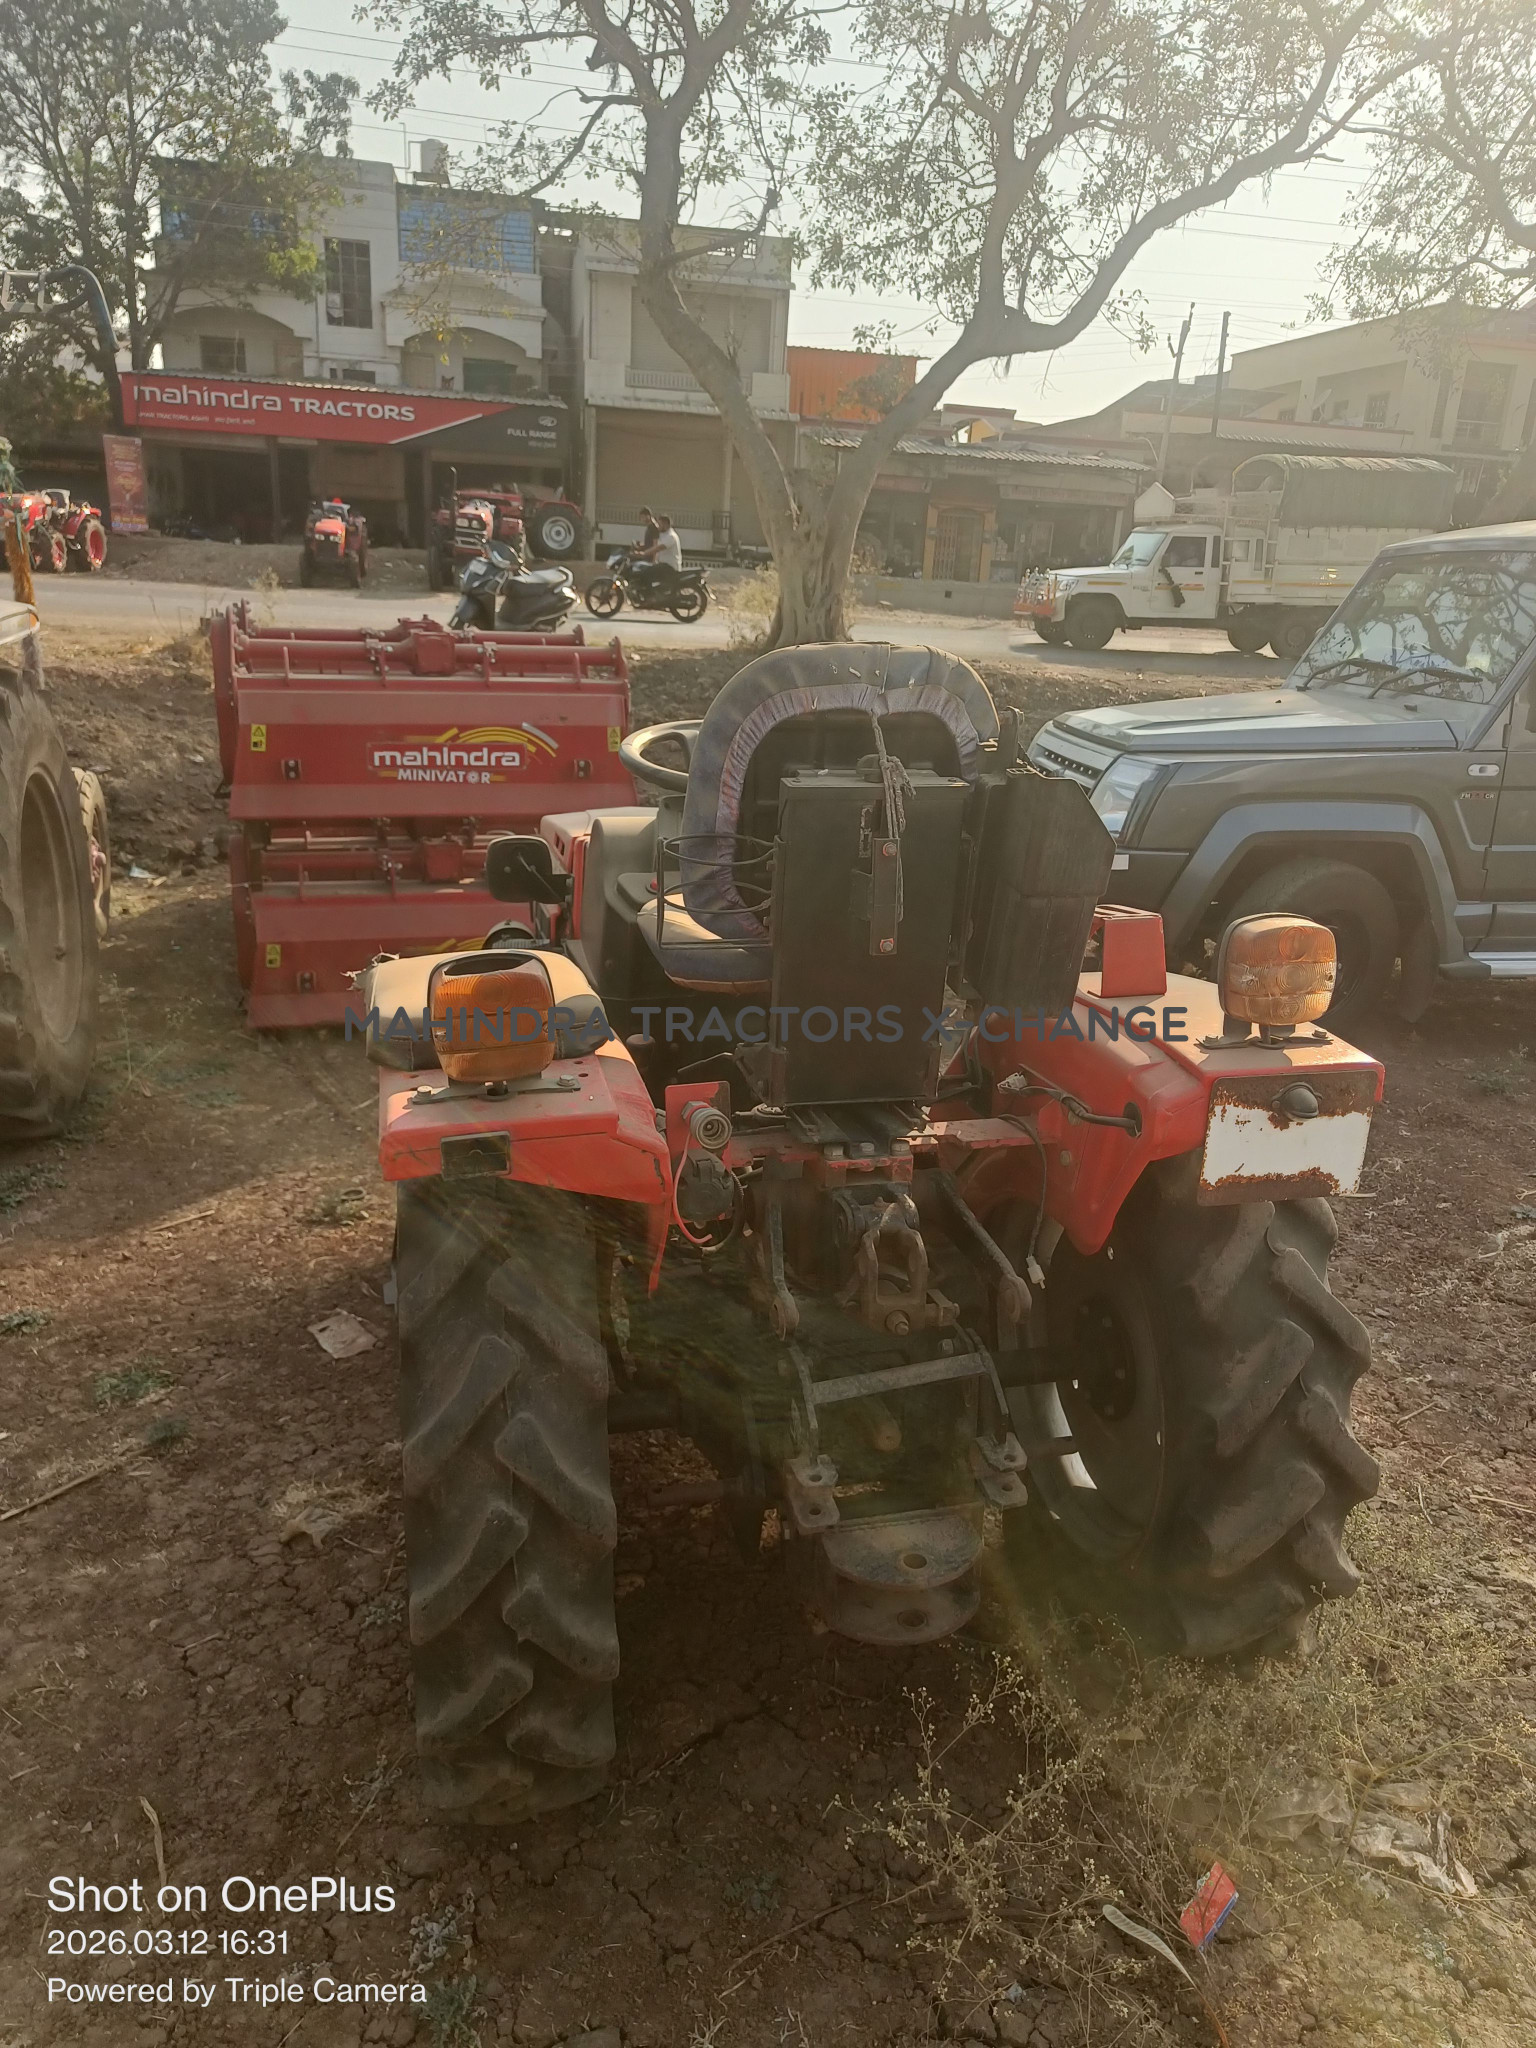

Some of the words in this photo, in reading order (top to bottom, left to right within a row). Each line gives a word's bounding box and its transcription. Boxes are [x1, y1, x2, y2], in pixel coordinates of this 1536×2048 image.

[133, 384, 282, 411] mahindra
[289, 397, 416, 421] TRACTORS
[373, 747, 520, 767] mahindra
[397, 769, 491, 784] MINIVATOR
